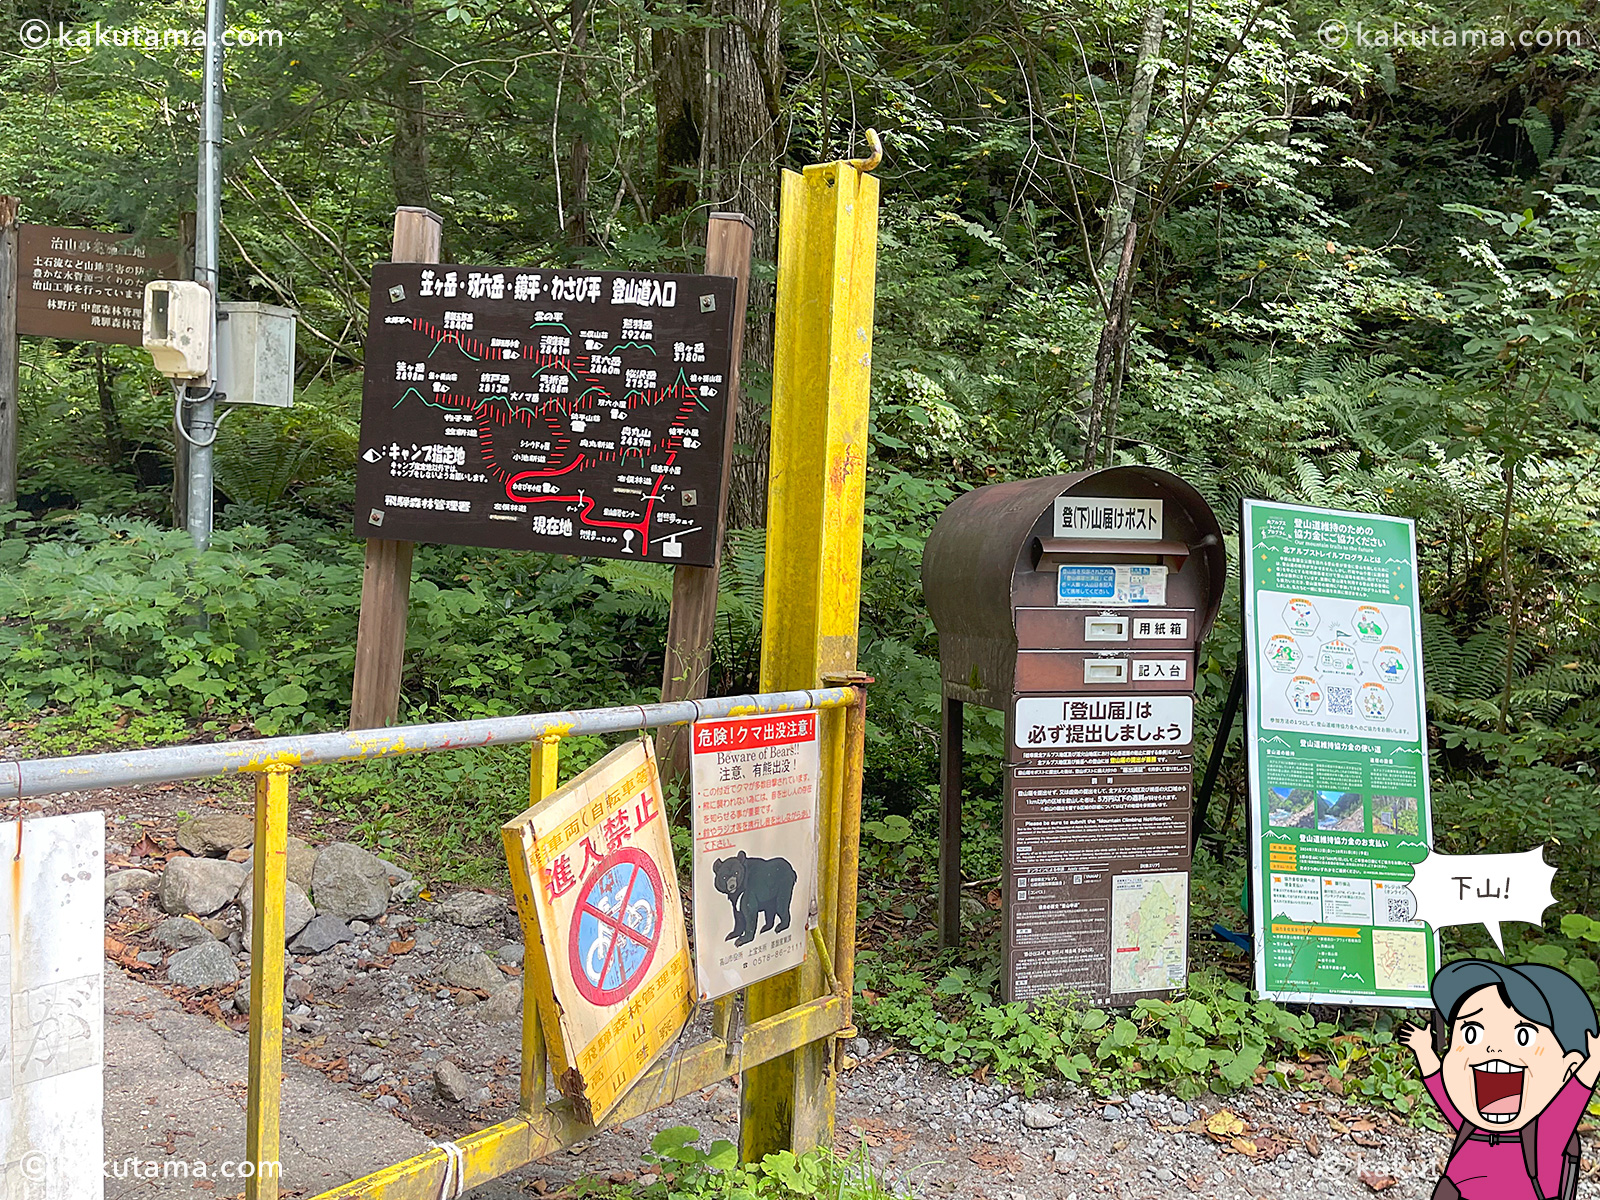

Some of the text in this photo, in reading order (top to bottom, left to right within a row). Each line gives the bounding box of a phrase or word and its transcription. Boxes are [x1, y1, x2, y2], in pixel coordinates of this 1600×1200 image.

[611, 277, 676, 307] 登山道入口
[47, 299, 76, 311] 林野庁
[533, 310, 563, 322] 雲の平
[621, 329, 652, 340] 2924m
[539, 344, 570, 355] 2841m
[590, 354, 621, 366] 双六岳
[673, 352, 705, 362] 3180m
[590, 364, 620, 375] 2860m
[478, 383, 508, 393] 2813m
[625, 378, 656, 389] 2755m
[532, 516, 573, 536] 現在地
[1293, 518, 1374, 536] 登山道維持のための
[1293, 529, 1387, 548] 協力金にご協力ください
[1305, 541, 1329, 549] mountain
[1283, 545, 1381, 564] 北アルプストレイルプログラムとは
[1139, 622, 1182, 635] 用紙箱
[1138, 664, 1181, 677] 記入台
[1062, 701, 1152, 721] 「登山届」は
[698, 719, 813, 747] 危険!クマ出没注意!
[1028, 723, 1182, 744] 必ず提出しましょう
[1300, 739, 1382, 754] 登山道維持協力金の使い道
[717, 744, 800, 765] Beware of Bears!!
[1299, 834, 1389, 848] 登山道維持協力金のお支払い
[545, 792, 659, 905] 進入禁止
[752, 942, 803, 966] 0578-86-2111
